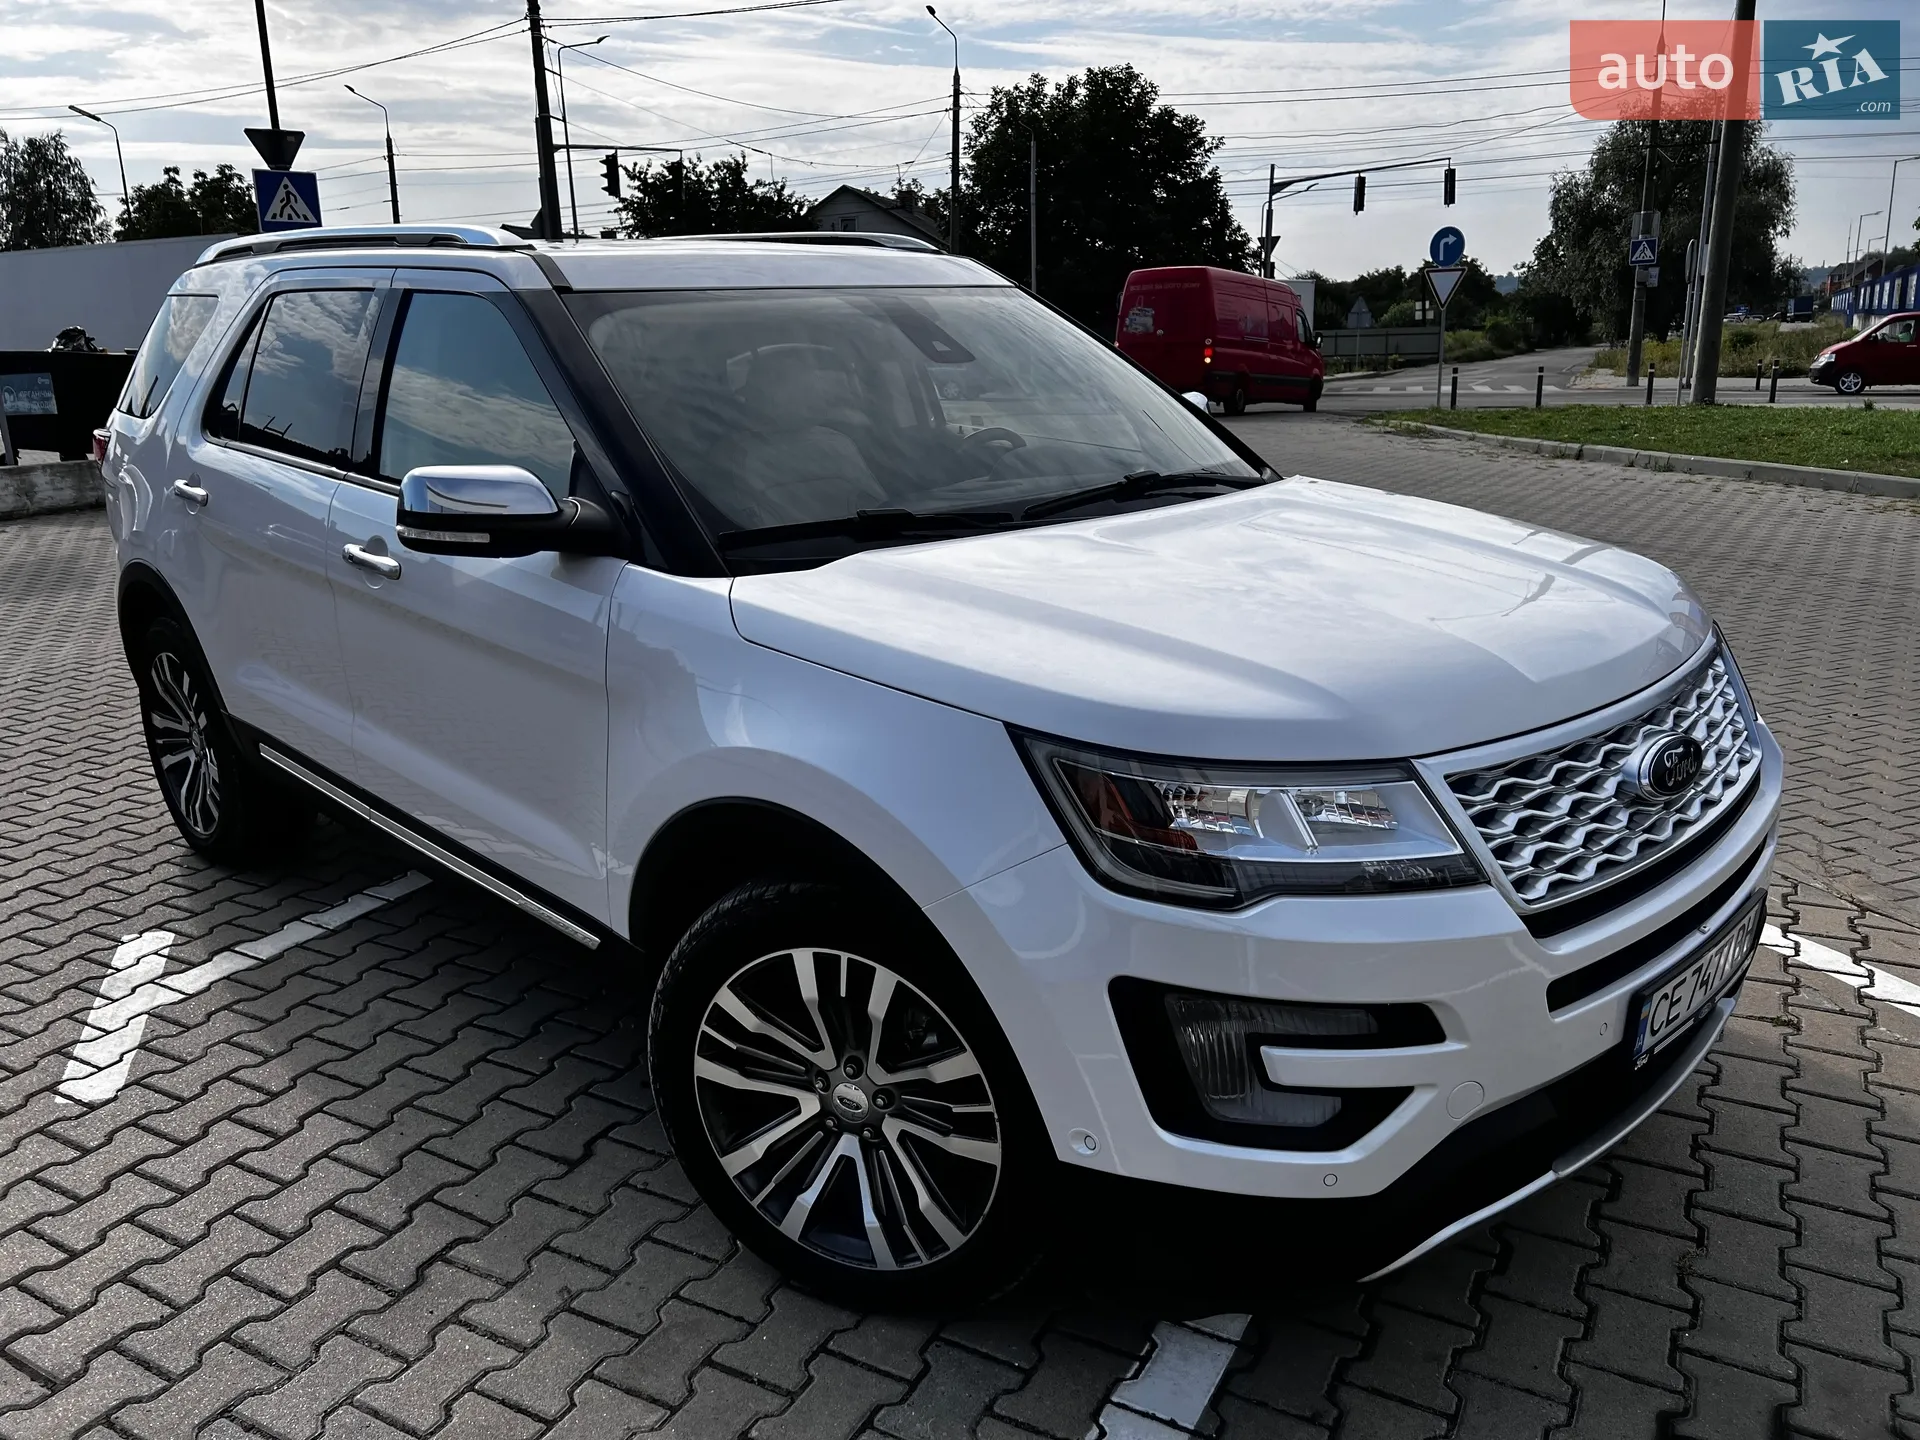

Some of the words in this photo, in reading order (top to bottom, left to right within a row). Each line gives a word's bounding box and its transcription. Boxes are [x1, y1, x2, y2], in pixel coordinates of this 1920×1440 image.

[1664, 744, 1697, 787] Ford
[1651, 976, 1687, 1037] CE
[1686, 934, 1735, 1012] 7477
